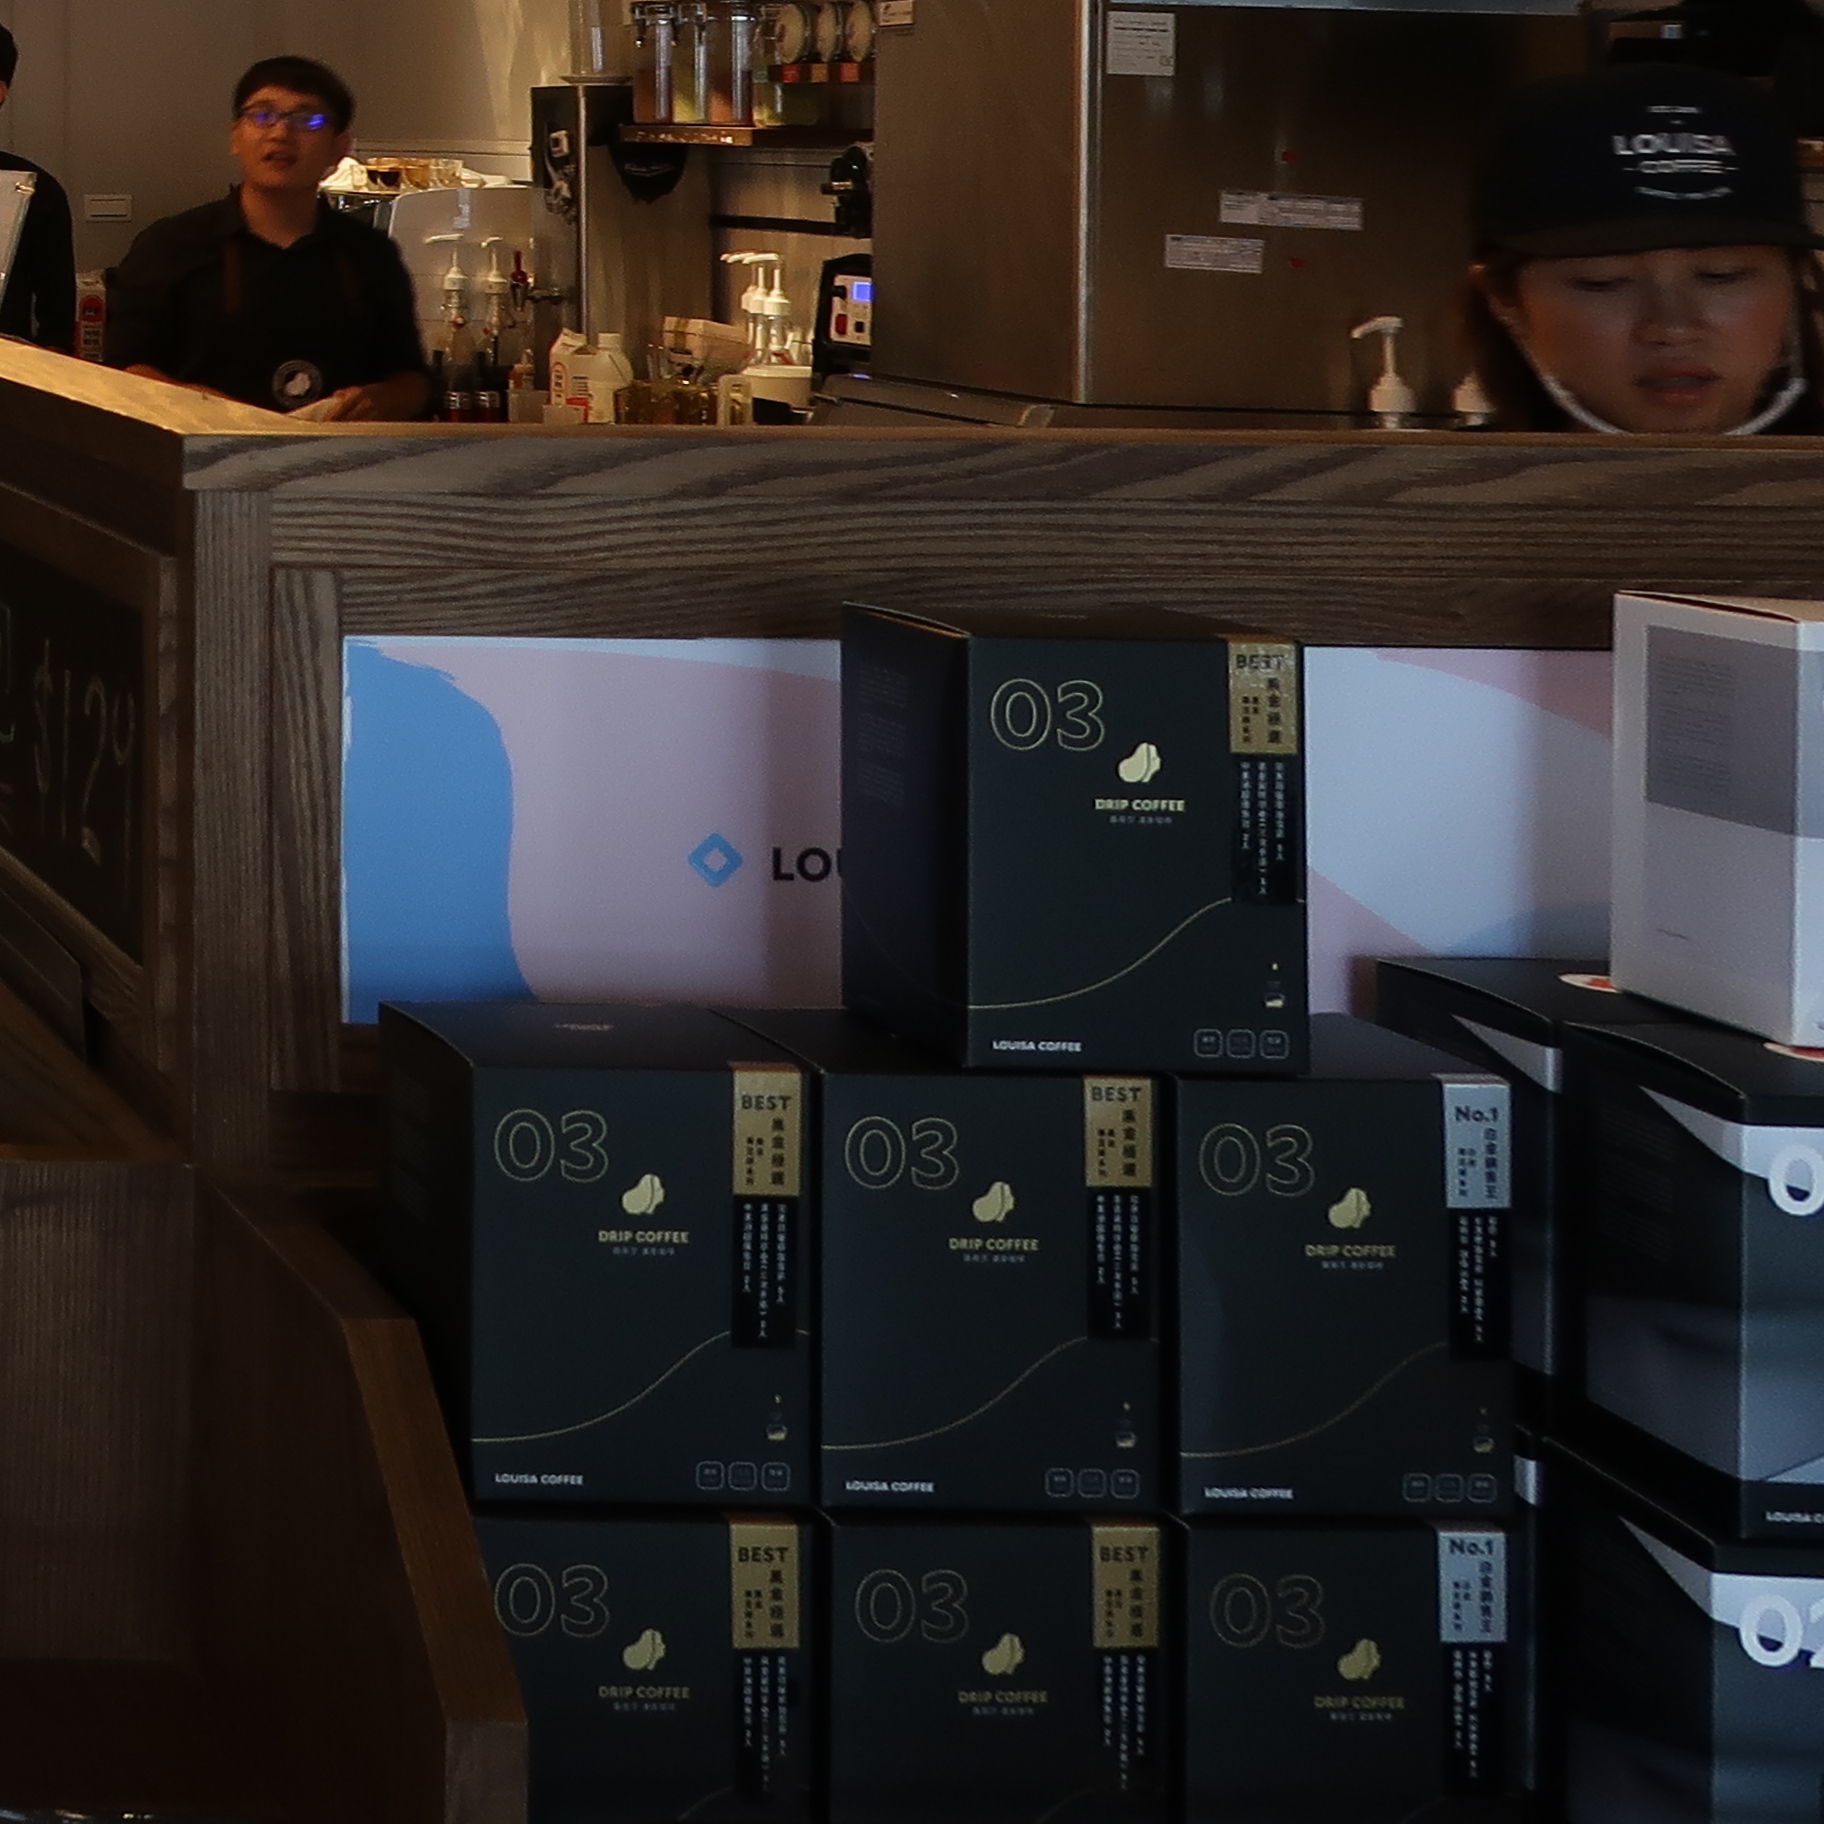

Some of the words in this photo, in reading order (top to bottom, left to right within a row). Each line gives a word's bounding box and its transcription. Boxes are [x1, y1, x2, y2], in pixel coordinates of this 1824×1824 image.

[1612, 133, 1737, 156] LOUISA
[990, 678, 1105, 752] 03
[34, 638, 136, 911] $129
[1095, 798, 1129, 812] DRIP
[1131, 798, 1186, 812] COFFEE
[773, 847, 841, 881] LO
[992, 1040, 1036, 1052] LOUISA
[1038, 1041, 1082, 1053] COFFEE
[1092, 1087, 1142, 1102] BEST
[742, 1095, 792, 1110] BEST
[1455, 1105, 1499, 1123] No.1
[494, 1108, 608, 1182] 03
[844, 1115, 960, 1190] 03
[1199, 1122, 1315, 1197] 03
[598, 1229, 633, 1243] DRIP
[635, 1230, 690, 1244] COFFEE
[948, 1237, 984, 1251] DRIP
[986, 1237, 1040, 1251] COFFEE
[1342, 1244, 1397, 1258] COFFEE
[495, 1472, 539, 1485] LOUISA
[540, 1473, 584, 1486] COFFEE
[845, 1480, 889, 1492] LOUISA
[891, 1481, 935, 1493] COFFEE
[738, 1547, 788, 1562] BEST
[1449, 1539, 1495, 1555] No.1
[1100, 1548, 1149, 1562] BEST
[494, 1563, 610, 1637] 03
[855, 1568, 969, 1643] 03
[1209, 1572, 1326, 1649] 03
[598, 1685, 634, 1699] DRIP
[636, 1685, 691, 1699] COFFEE
